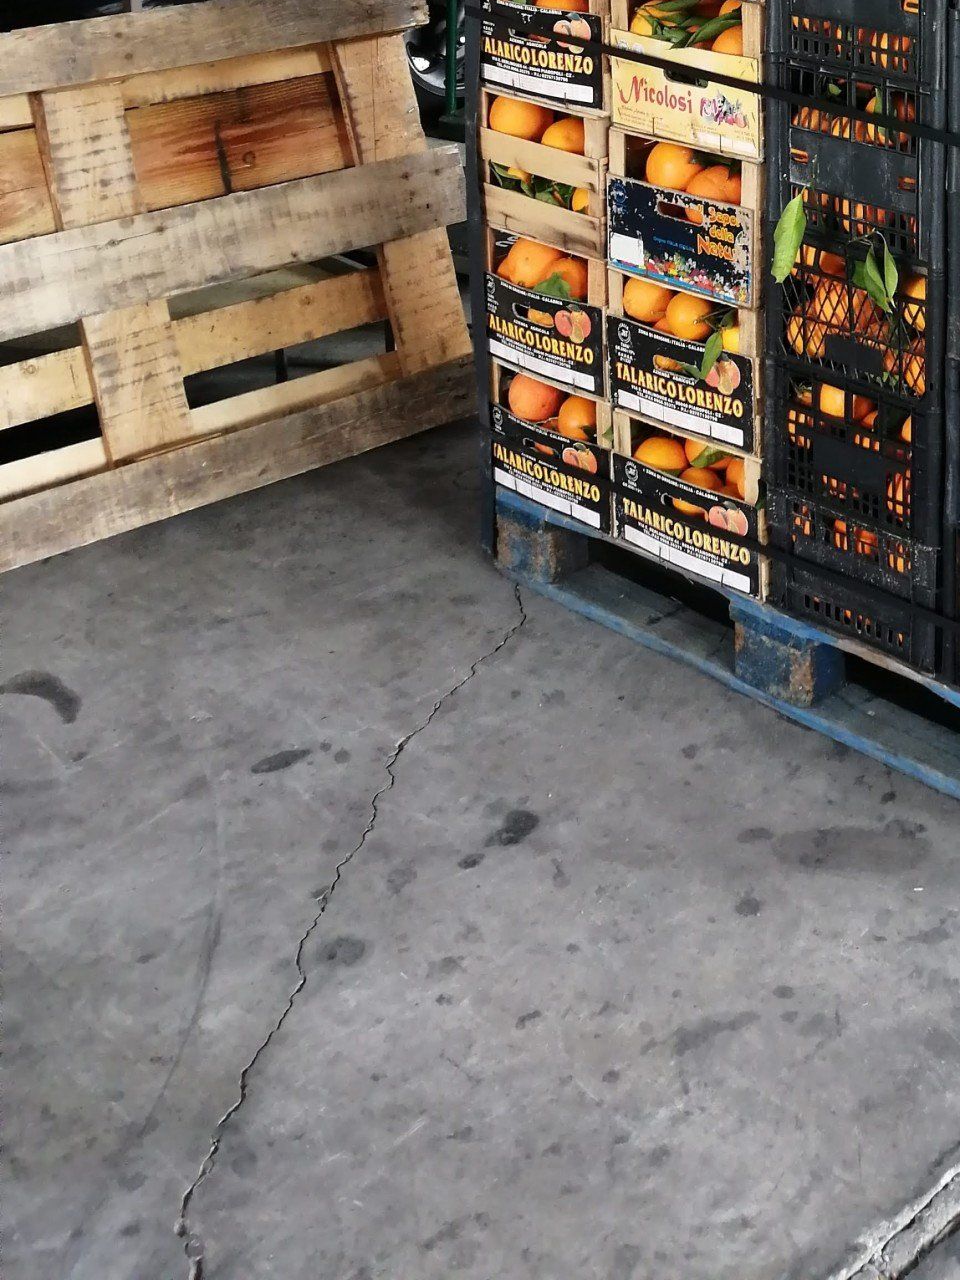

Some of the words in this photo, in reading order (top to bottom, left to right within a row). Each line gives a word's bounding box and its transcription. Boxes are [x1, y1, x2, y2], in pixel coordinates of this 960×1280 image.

[484, 36, 531, 65] ALARICO
[531, 49, 594, 75] LORENZO
[616, 75, 693, 114] Nicolosi
[488, 313, 535, 347] ALARICO
[535, 333, 594, 365] LORENZO
[615, 361, 677, 398] TALARICO
[678, 383, 744, 418] LORENZO
[493, 442, 543, 480] ALARICO
[542, 465, 600, 503] LORENZO
[622, 497, 685, 540] TALARICO
[684, 525, 751, 566] LORENZO
